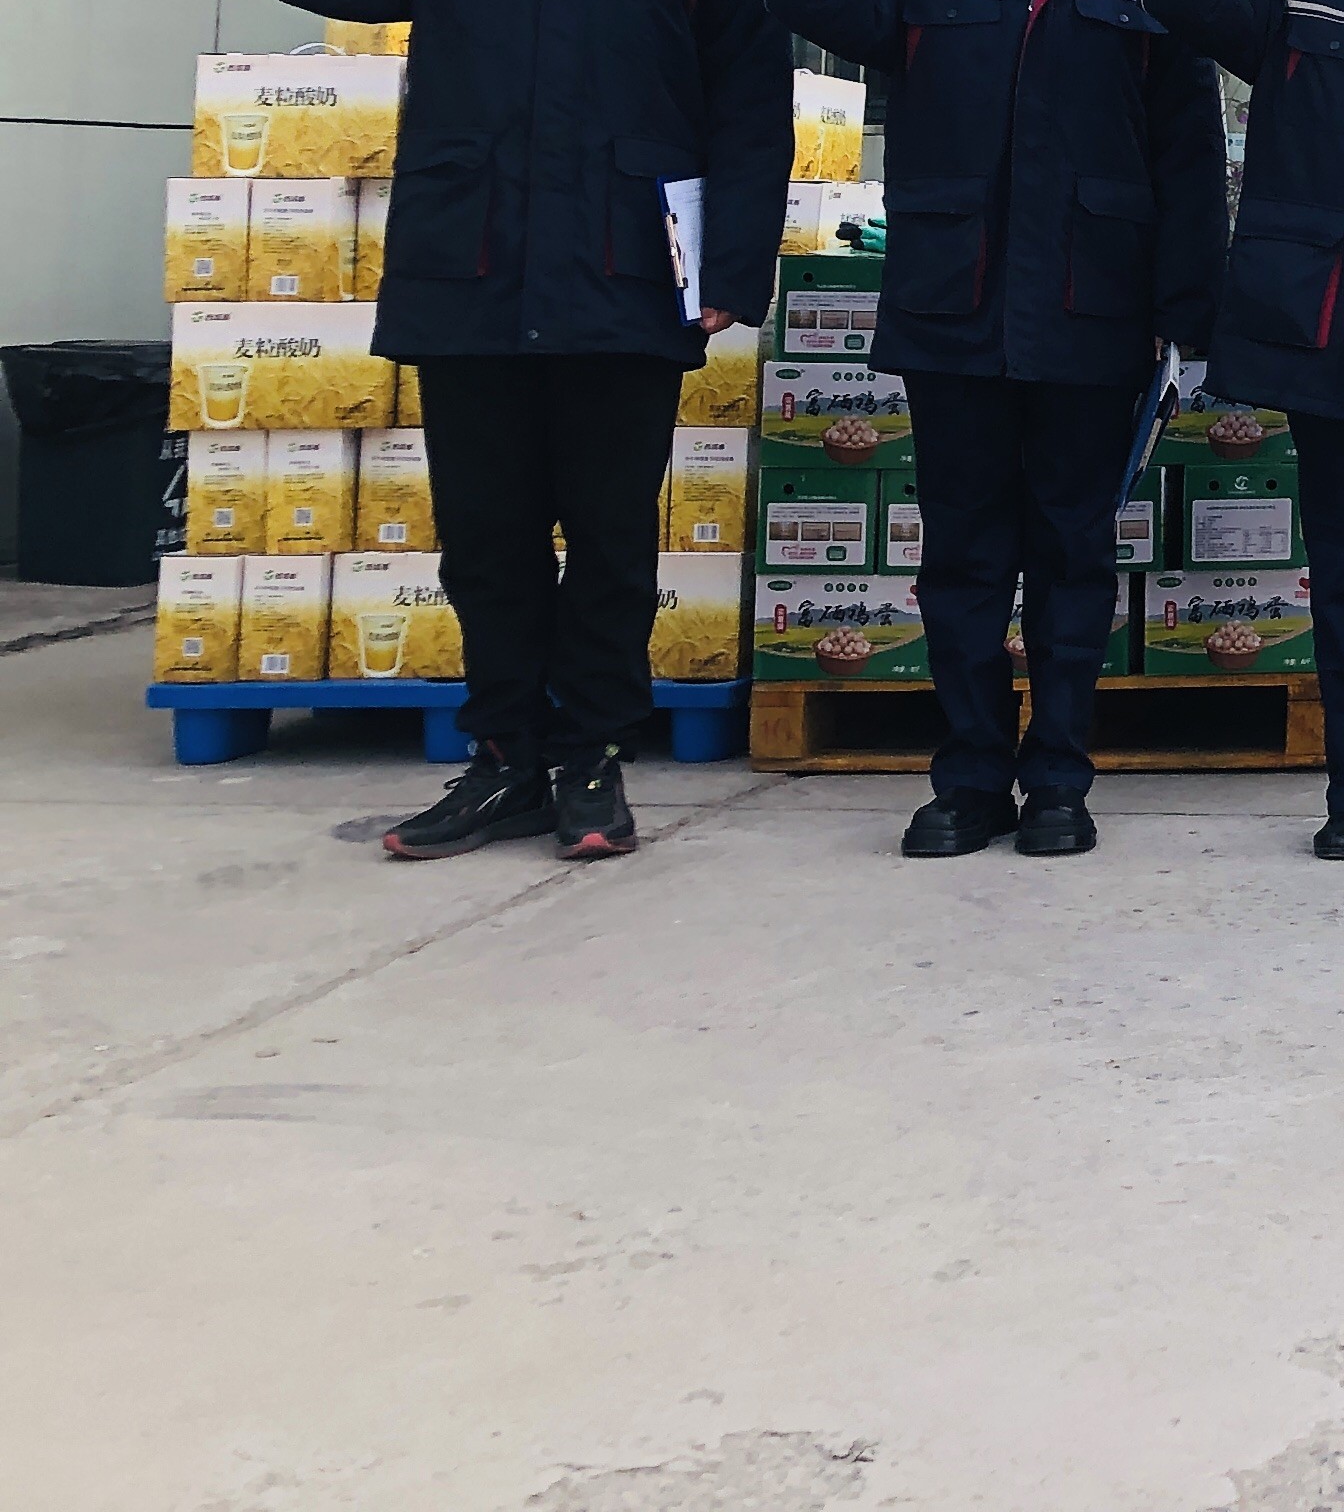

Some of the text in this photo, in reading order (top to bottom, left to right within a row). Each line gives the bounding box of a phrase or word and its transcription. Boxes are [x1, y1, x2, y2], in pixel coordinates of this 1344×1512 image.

[253, 86, 338, 107] 麦粒酸奶
[232, 337, 321, 359] 麦粒酸奶
[798, 599, 899, 628] 富硒鸡蛋
[1187, 595, 1289, 624] 富硒鸡蛋
